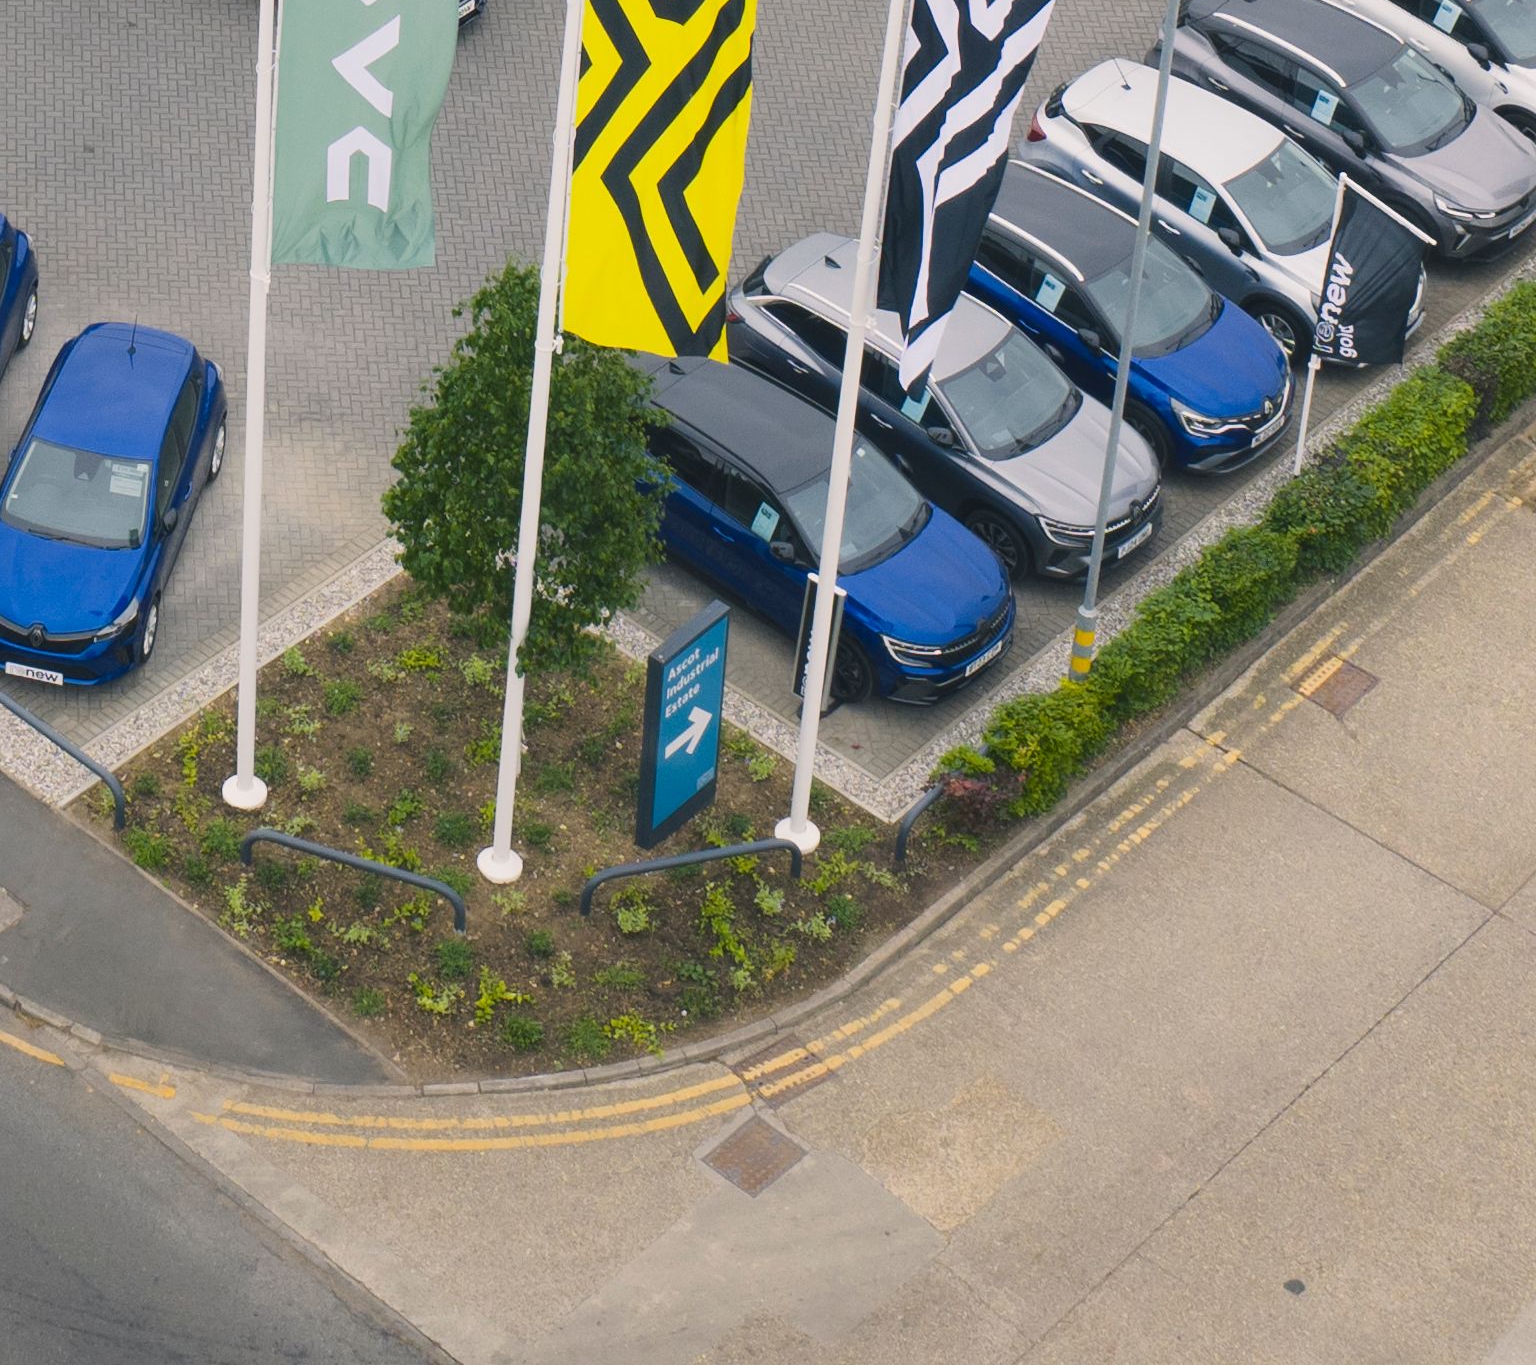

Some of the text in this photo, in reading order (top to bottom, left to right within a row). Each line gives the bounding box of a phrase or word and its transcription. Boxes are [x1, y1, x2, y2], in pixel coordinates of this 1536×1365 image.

[1314, 251, 1356, 354] renew
[1338, 323, 1358, 359] gold
[665, 647, 720, 700] Industrial
[667, 647, 701, 681] Ascot
[665, 682, 701, 719] Estate
